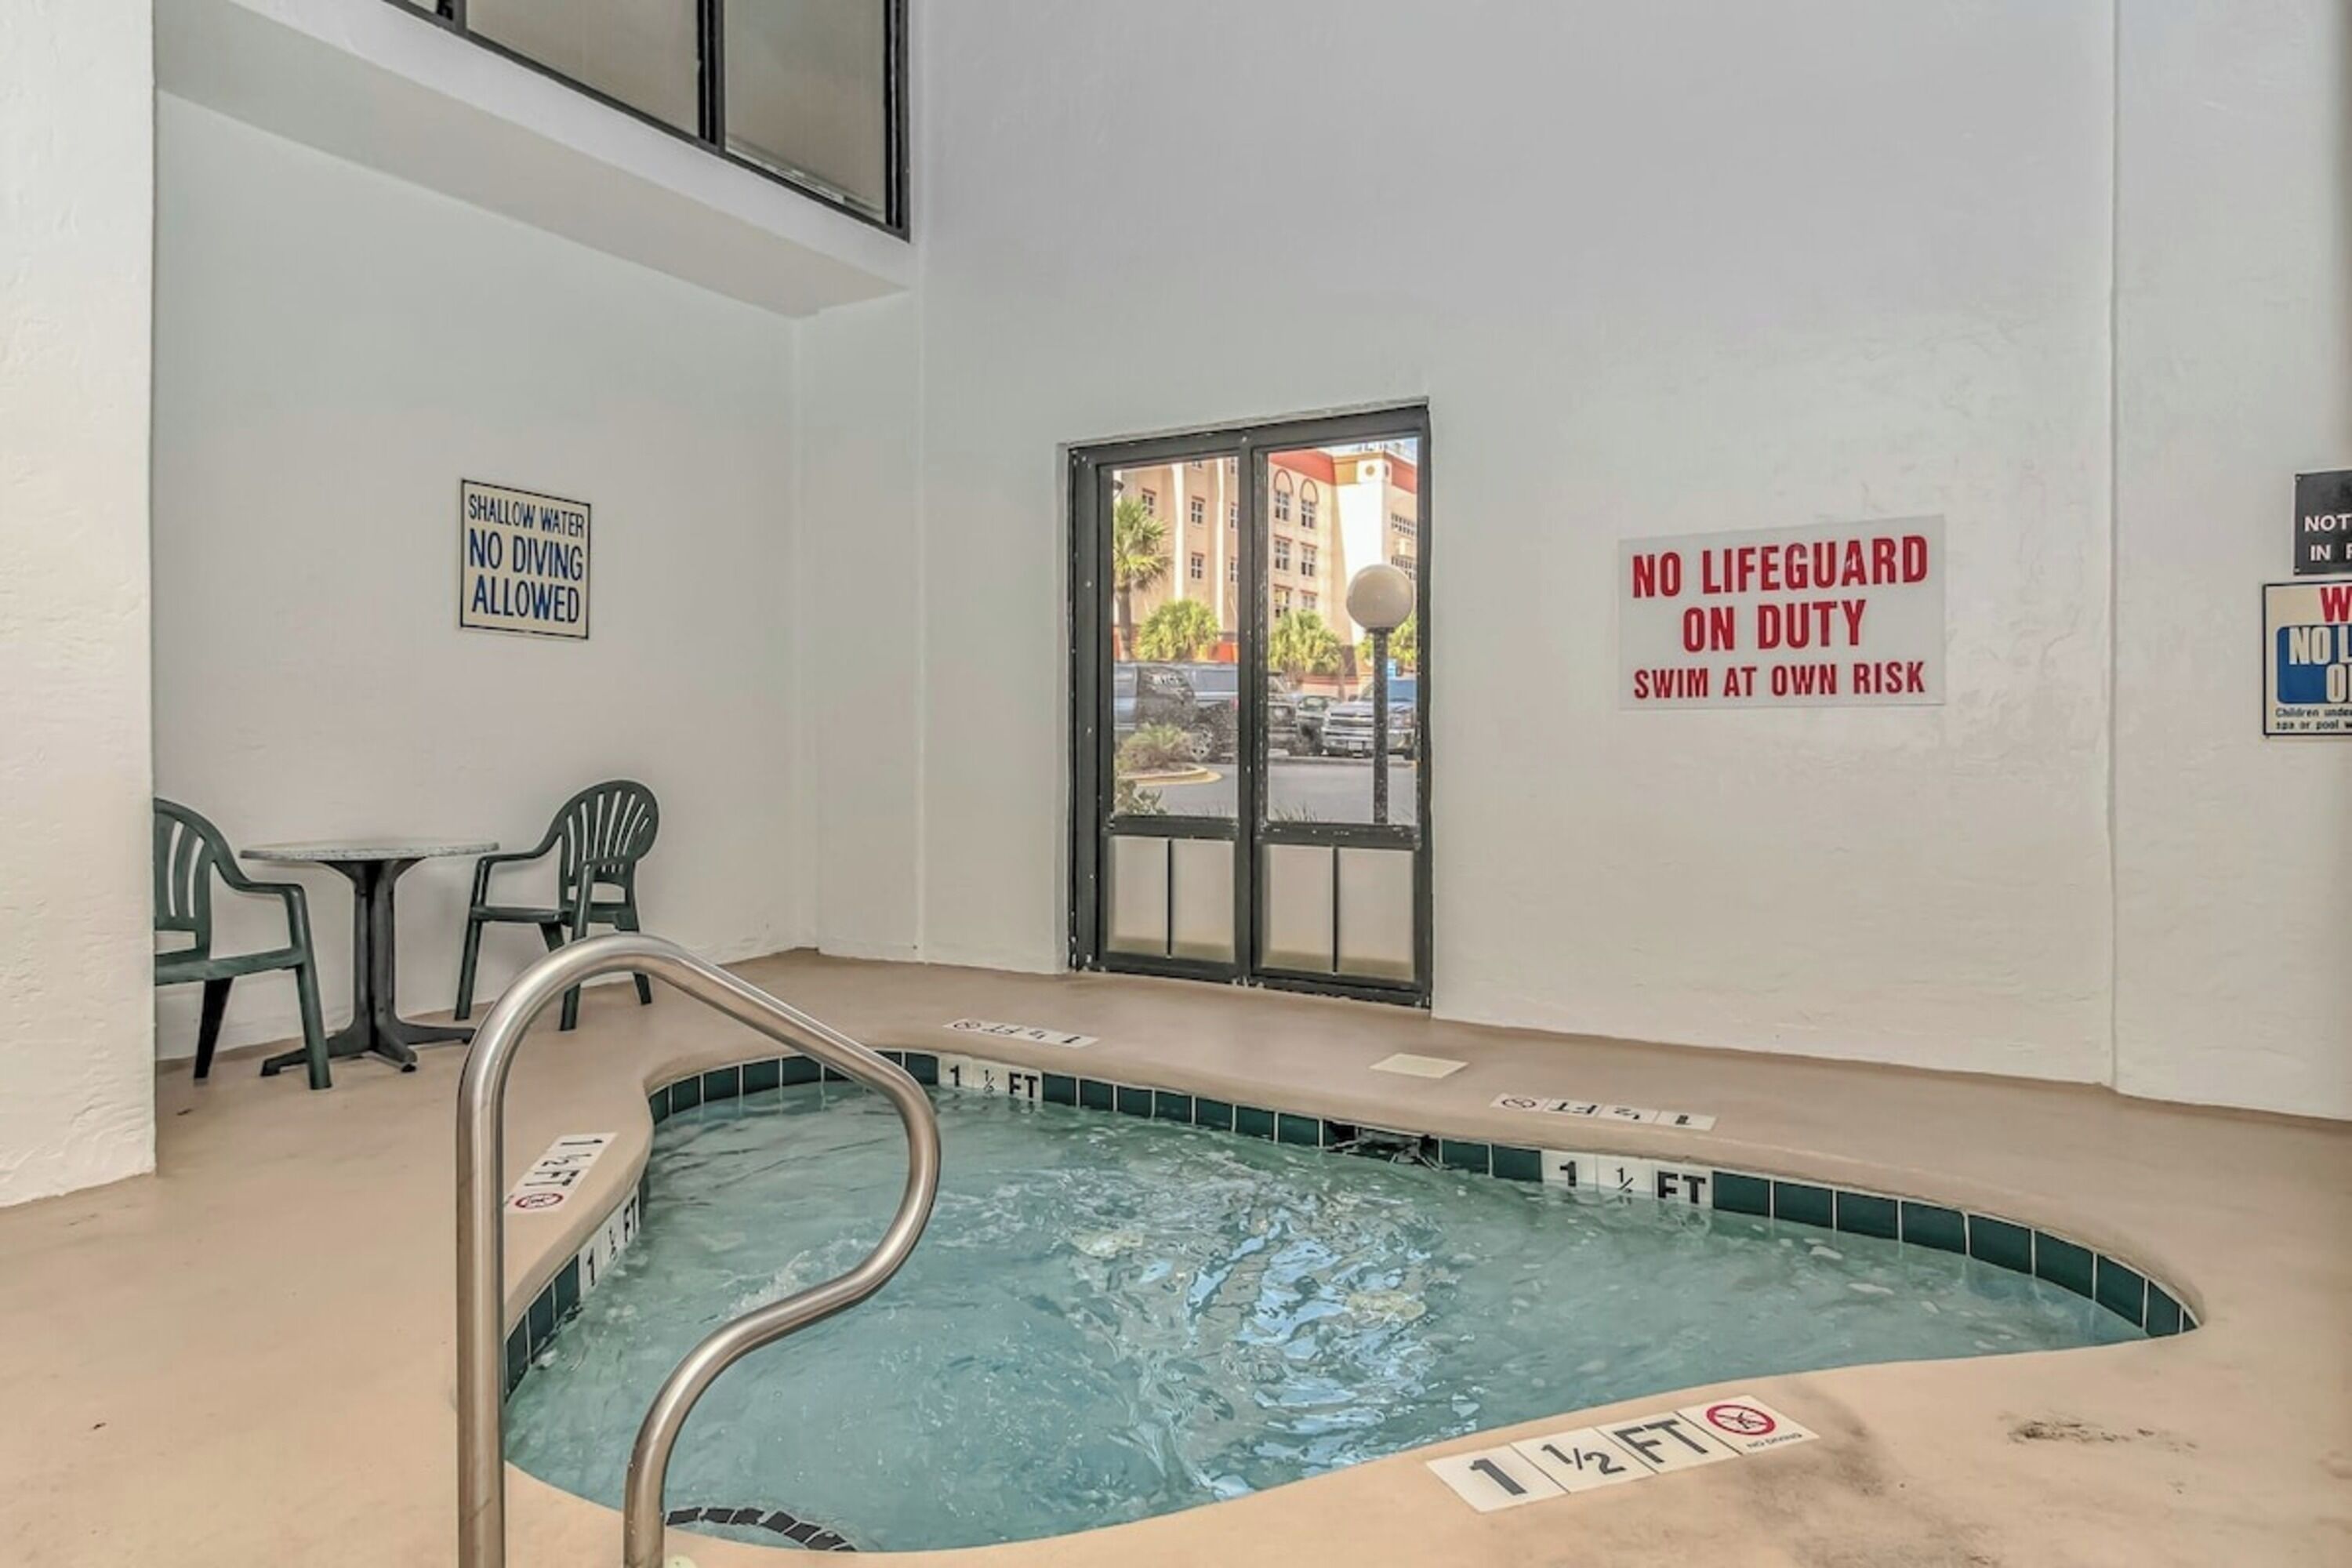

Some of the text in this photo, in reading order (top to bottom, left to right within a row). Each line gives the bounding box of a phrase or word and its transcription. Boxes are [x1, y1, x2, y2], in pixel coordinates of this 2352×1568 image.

[469, 493, 585, 538] SHALLOW WATER
[2304, 514, 2352, 532] NOT
[470, 528, 583, 581] NO DIVING
[1632, 535, 1929, 598] NO LIFEGUARD
[2310, 543, 2332, 561] IN
[472, 575, 580, 623] ALLOWED
[1683, 599, 1867, 652] ON DUTY
[2288, 626, 2332, 665] NO
[1634, 661, 1926, 699] SWIM AT OWN RISK
[2326, 664, 2352, 702] O
[2275, 707, 2319, 717] Children
[2316, 719, 2339, 730] pool
[949, 1065, 960, 1087] 1
[1008, 1071, 1039, 1098] FT
[1548, 1102, 1599, 1116] FT
[524, 1169, 580, 1186] FT
[1559, 1160, 1577, 1187] 1
[1657, 1171, 1707, 1205] FT
[586, 1247, 595, 1287] 1
[623, 1196, 637, 1243] FT
[1468, 1457, 1527, 1496] 1
[1612, 1418, 1709, 1464] FT
